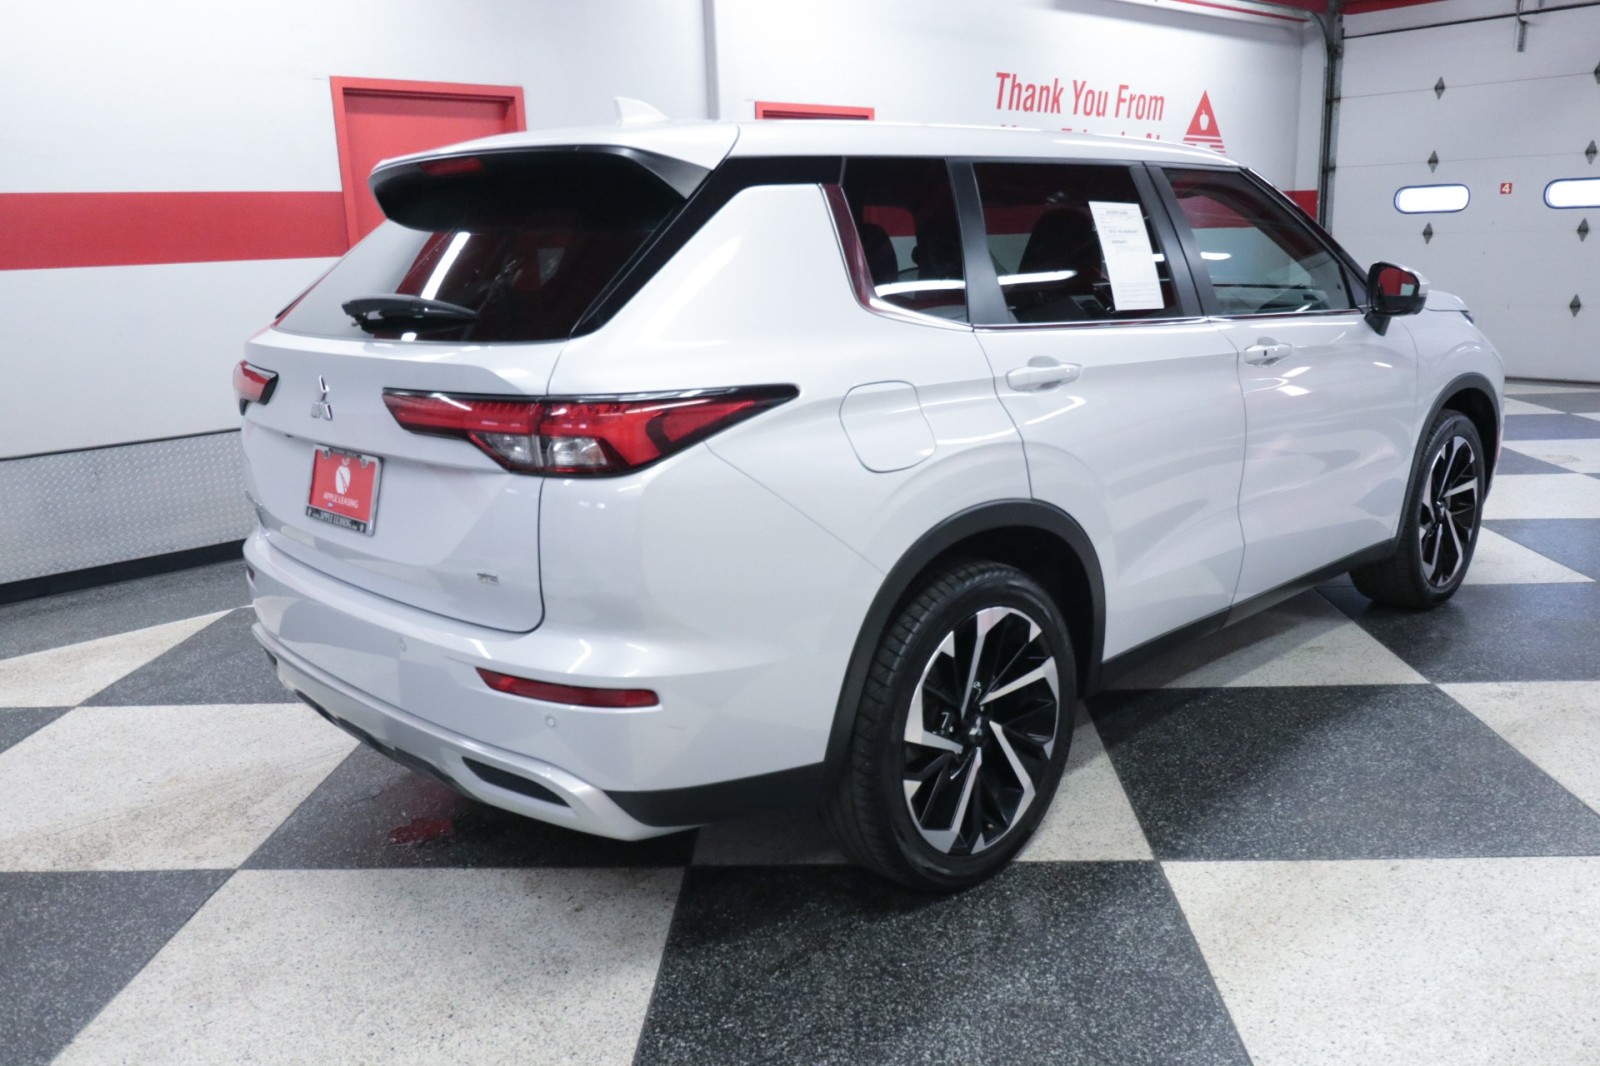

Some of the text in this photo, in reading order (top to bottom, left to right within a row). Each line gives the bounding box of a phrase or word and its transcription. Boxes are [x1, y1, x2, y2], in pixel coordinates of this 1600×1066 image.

[996, 72, 1165, 121] Thank You From
[1502, 183, 1511, 193] 4
[323, 492, 359, 509] APPLE LEASING
